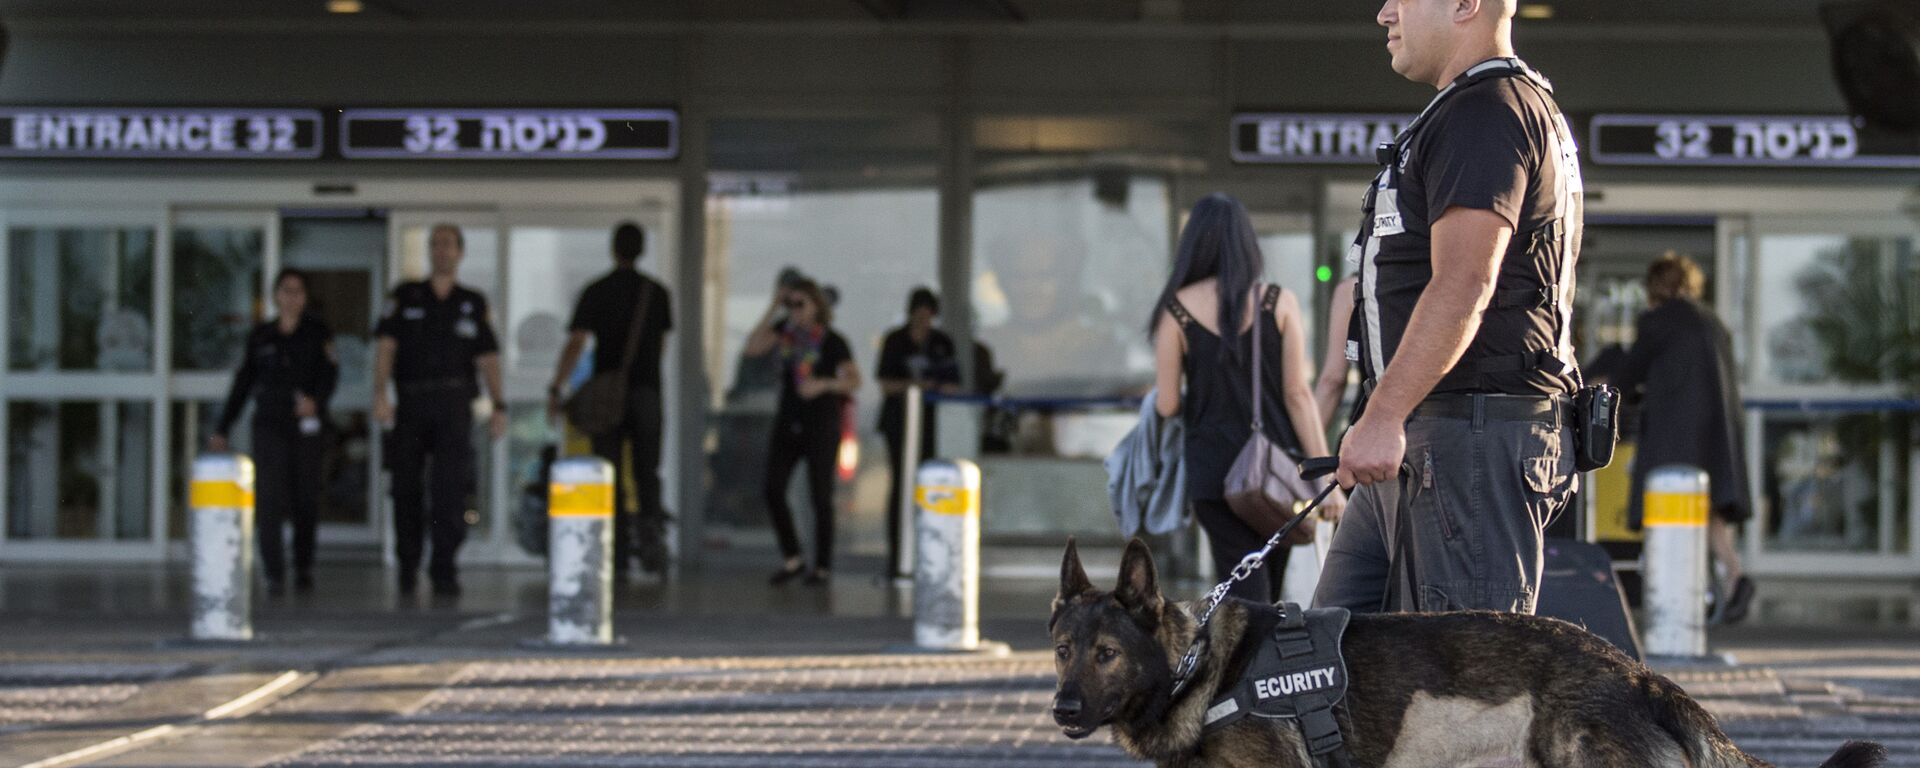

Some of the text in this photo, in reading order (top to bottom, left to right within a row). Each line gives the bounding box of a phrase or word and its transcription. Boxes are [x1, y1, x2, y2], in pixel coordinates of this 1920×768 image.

[13, 114, 297, 152] ENTRANCE 32
[404, 115, 607, 152] כניסה 32
[1258, 120, 1408, 154] ENTRA
[1655, 121, 1858, 159] כניסה 32
[1255, 667, 1335, 699] ECURITY
